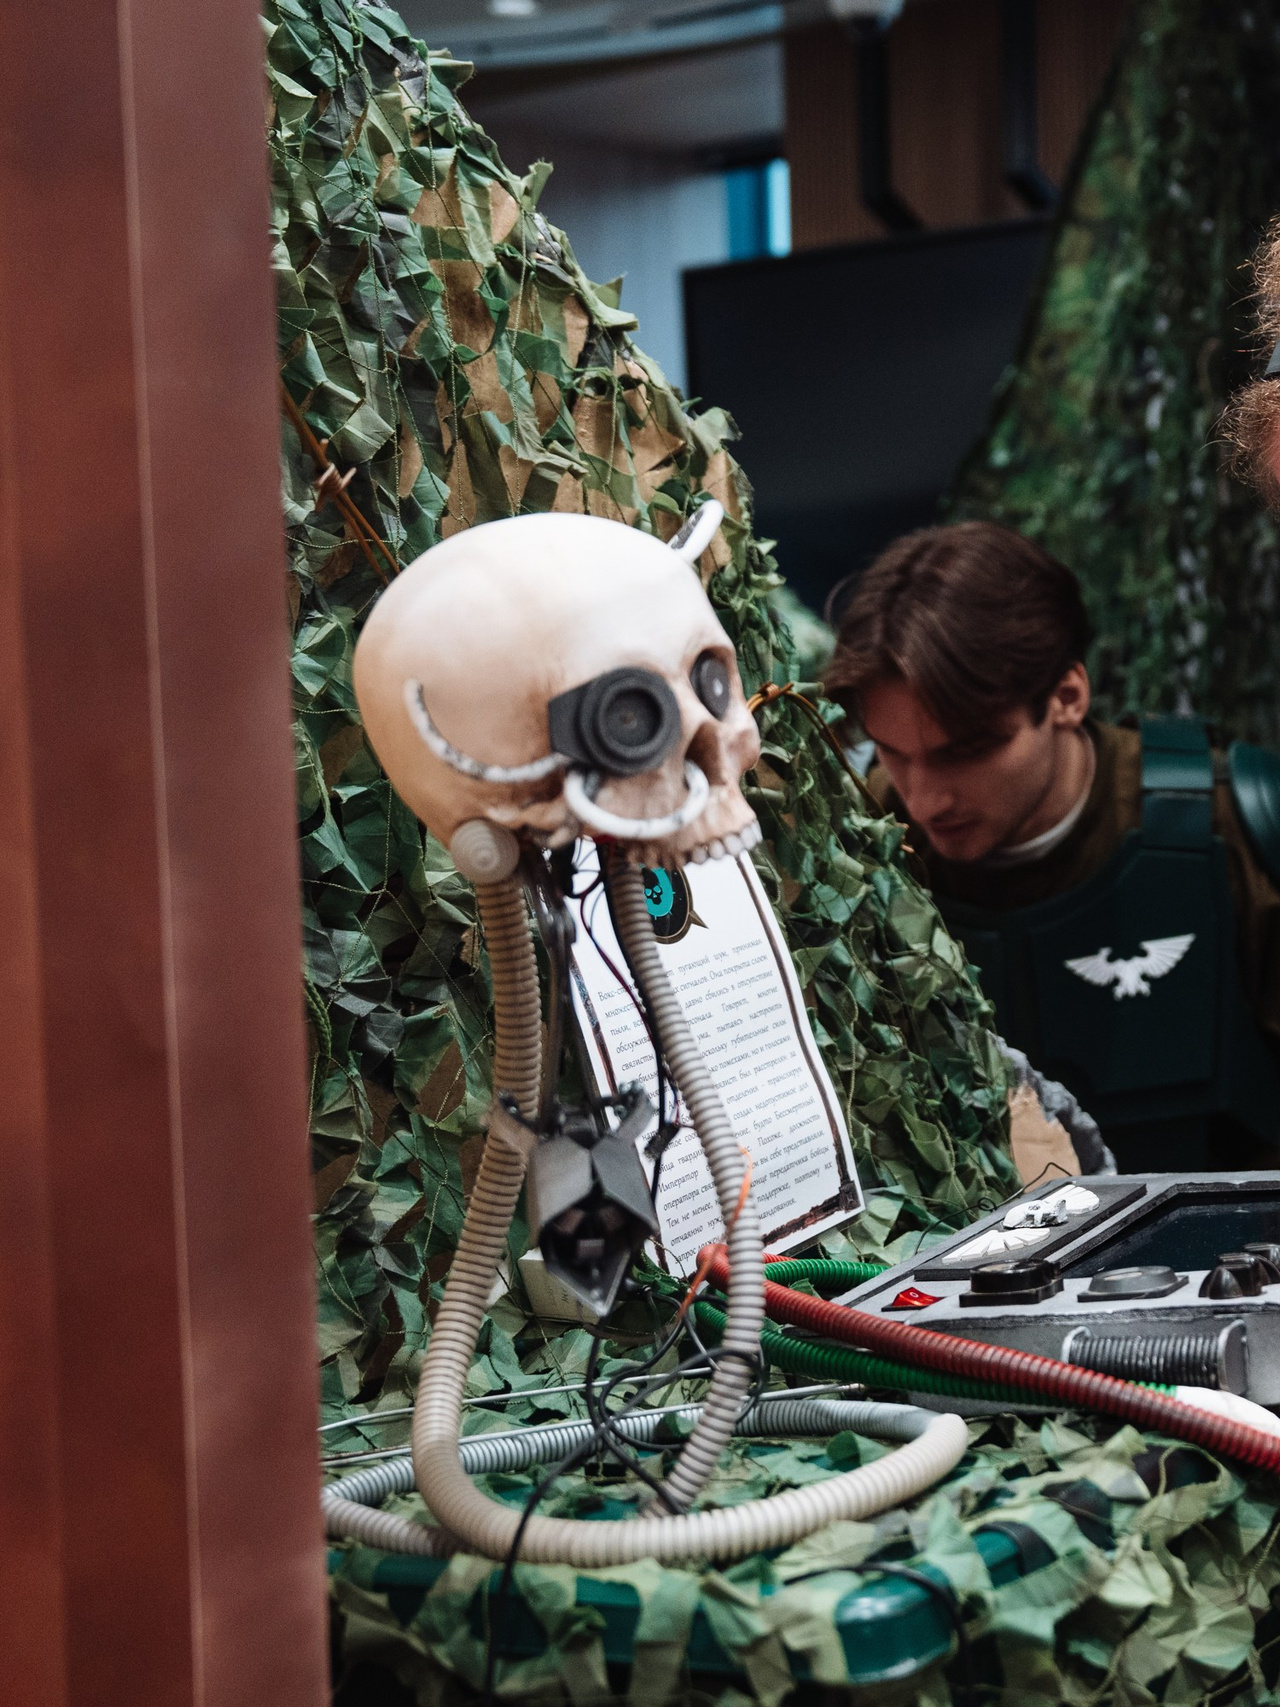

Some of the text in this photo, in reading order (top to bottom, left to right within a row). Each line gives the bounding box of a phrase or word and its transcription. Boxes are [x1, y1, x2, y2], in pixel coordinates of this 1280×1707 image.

[677, 954, 711, 976] пугающий
[603, 1000, 635, 1019] множест
[708, 968, 724, 981] Она
[684, 995, 703, 1010] давно
[703, 984, 729, 1001] сбились
[613, 1031, 651, 1057] обслужива
[700, 1041, 729, 1060] оскольку
[714, 1075, 738, 1090] вязист
[758, 1196, 798, 1220] мандования.
[665, 1215, 680, 1229] Тем
[680, 1212, 691, 1222] не
